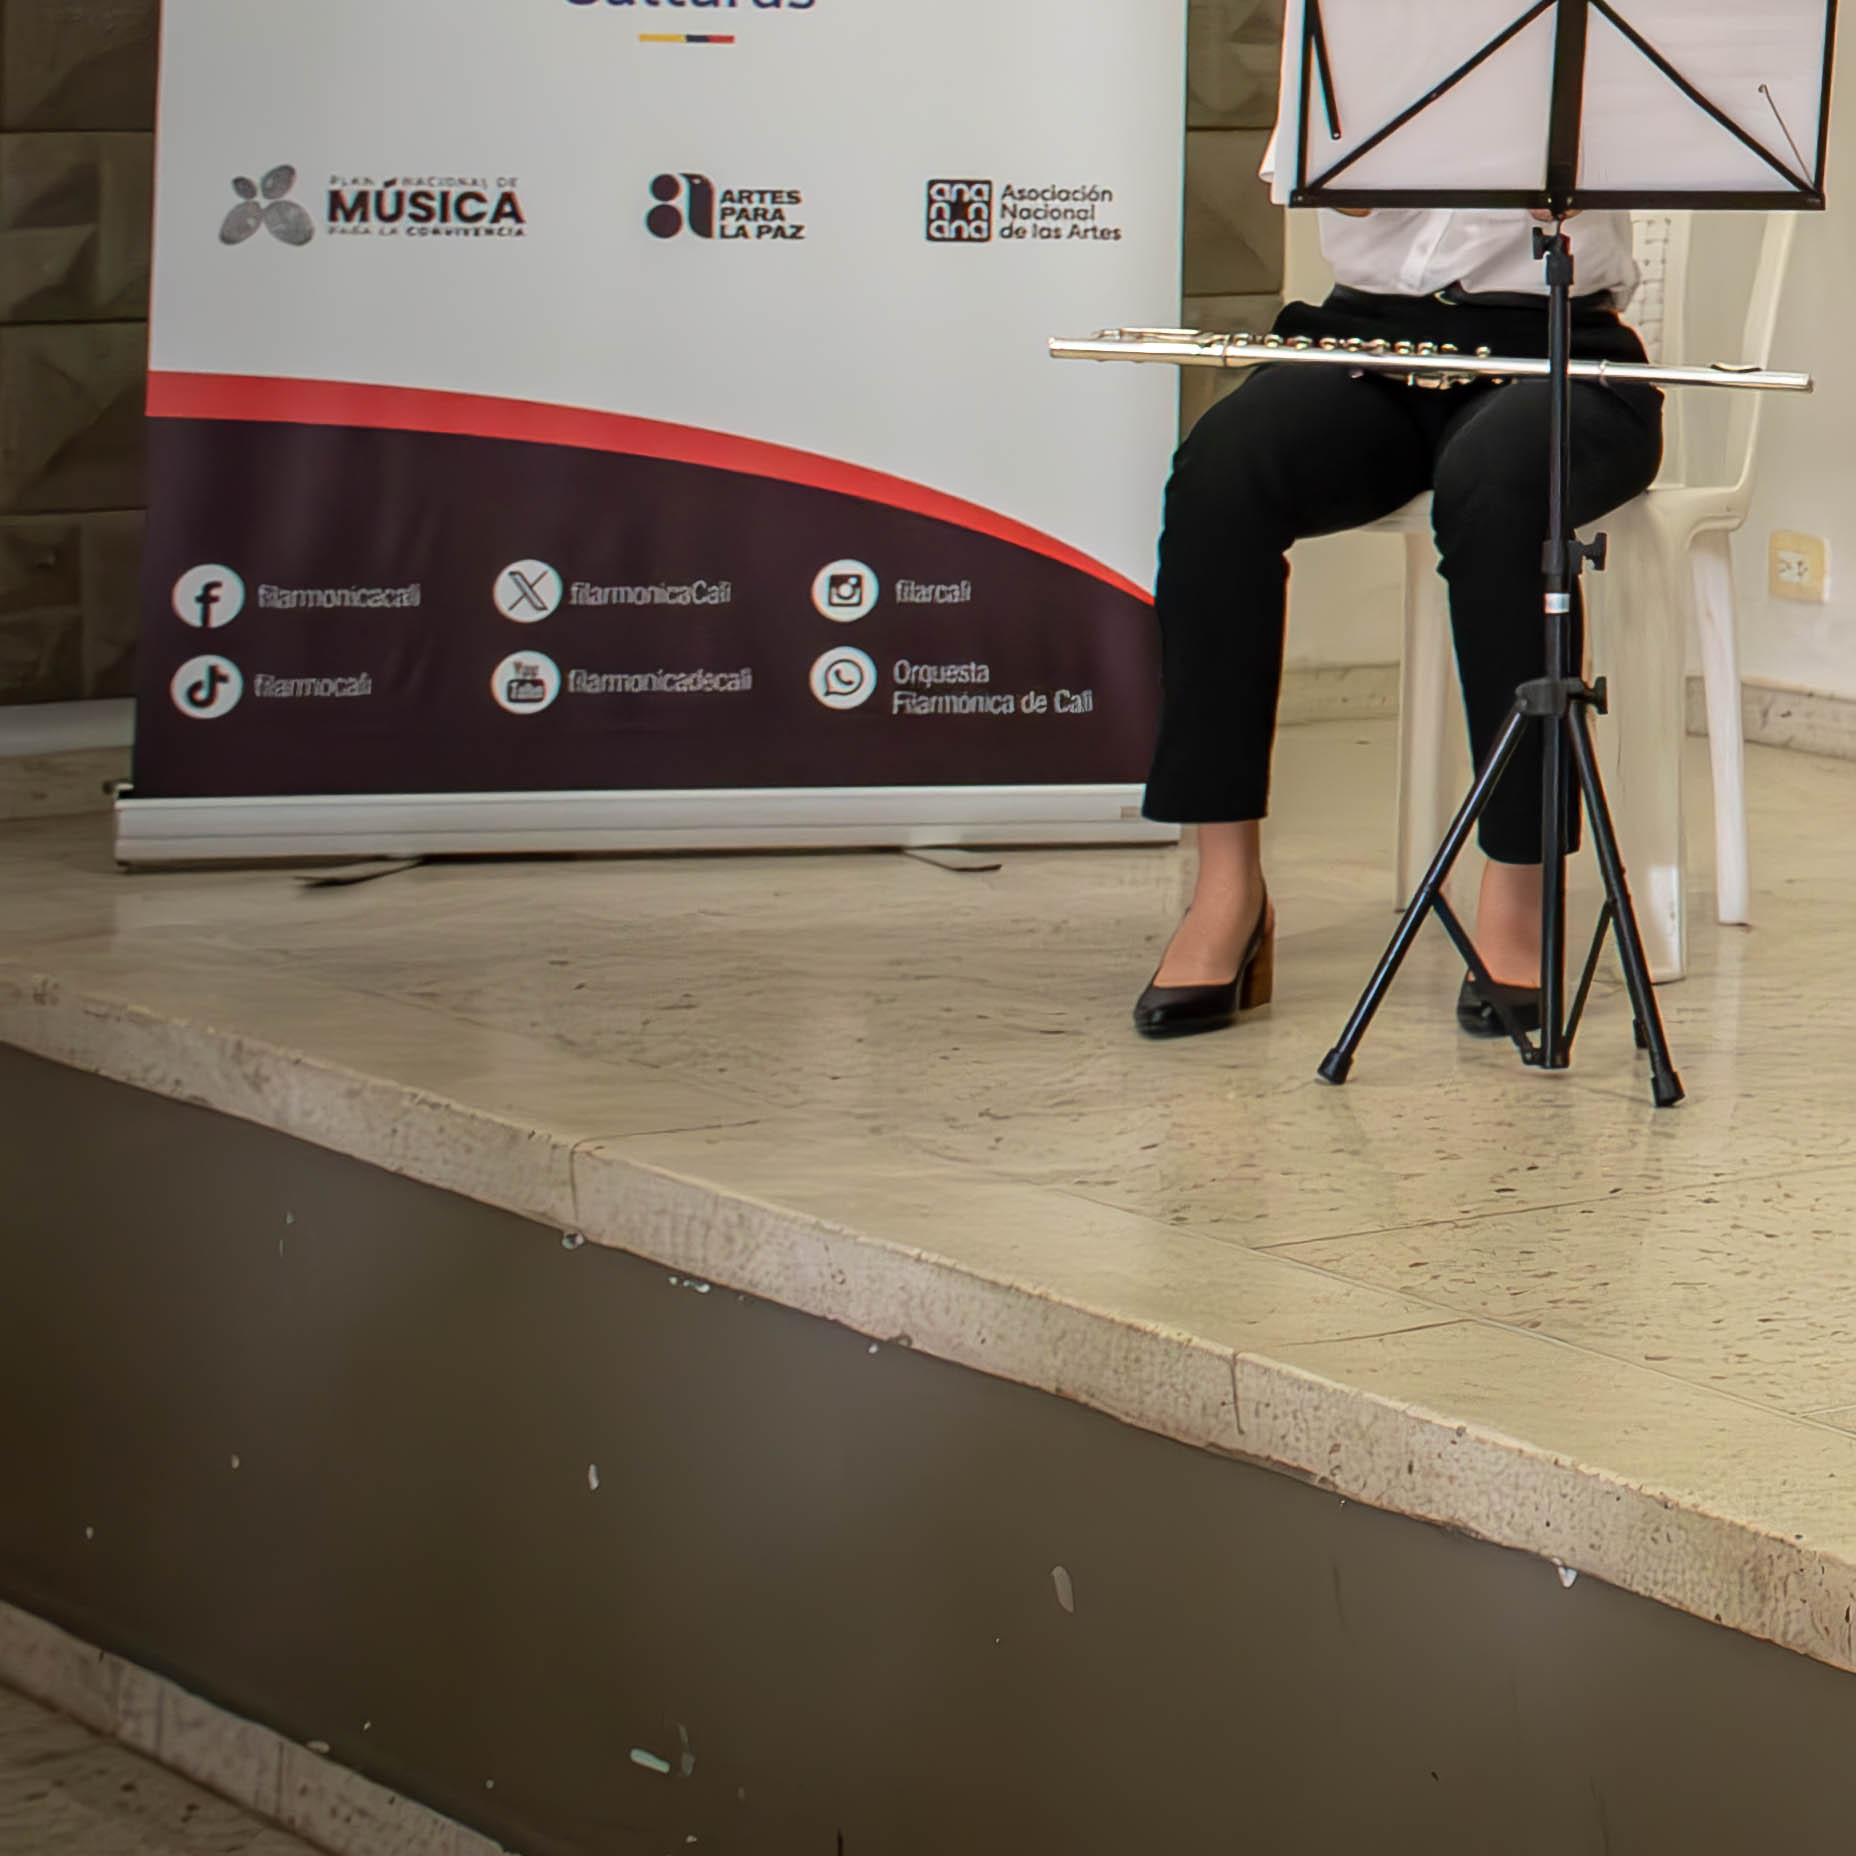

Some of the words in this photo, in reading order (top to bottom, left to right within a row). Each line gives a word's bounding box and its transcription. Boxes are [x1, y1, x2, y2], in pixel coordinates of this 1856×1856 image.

[328, 178, 526, 223] MÚSICA
[720, 189, 802, 204] ARTES
[1001, 184, 1113, 201] Asociación
[720, 207, 785, 221] PARA
[1001, 204, 1095, 221] Nacional
[720, 225, 750, 239] LA
[757, 225, 805, 239] PAZ
[1000, 223, 1026, 239] de
[1033, 223, 1061, 239] las
[1067, 224, 1121, 240] Artes
[894, 659, 989, 688] Orquesta
[892, 690, 1015, 714] Filarmónica
[1021, 691, 1048, 714] de
[1054, 689, 1094, 714] Cali
